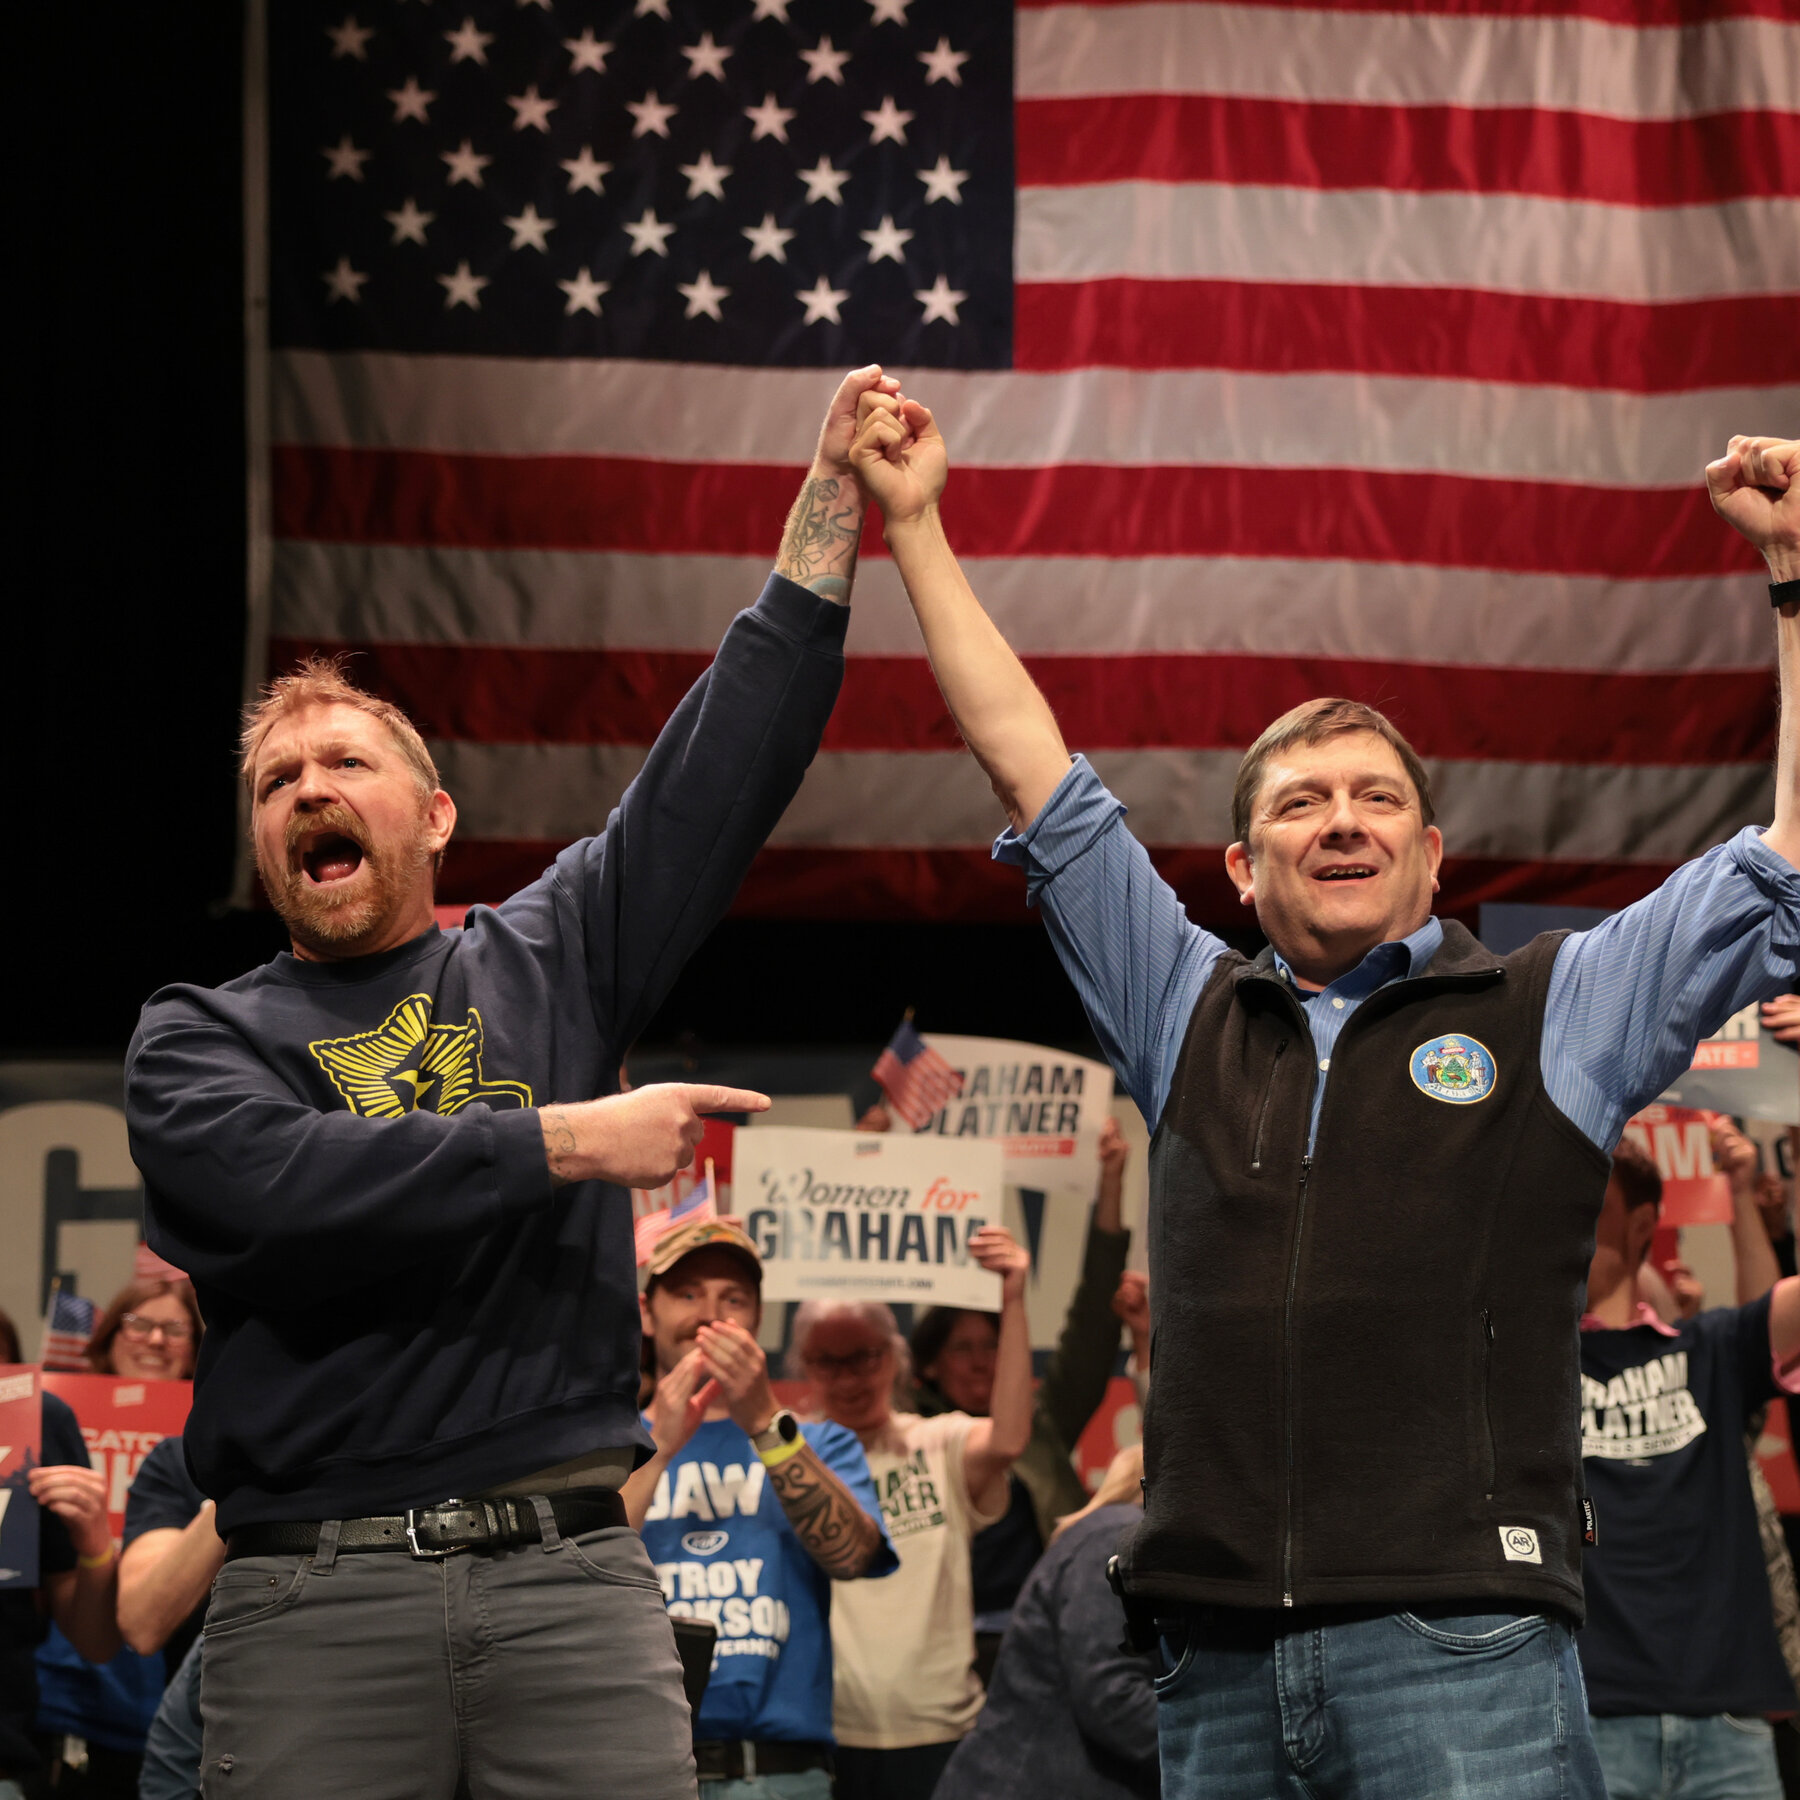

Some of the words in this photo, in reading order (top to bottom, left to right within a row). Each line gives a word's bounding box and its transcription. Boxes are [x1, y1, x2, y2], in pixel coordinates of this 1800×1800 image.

[760, 1168, 910, 1209] Women
[920, 1176, 980, 1212] for
[1581, 1388, 1698, 1439] LATNER
[1583, 1500, 1593, 1531] POLARTEC
[655, 1558, 764, 1600] TROY
